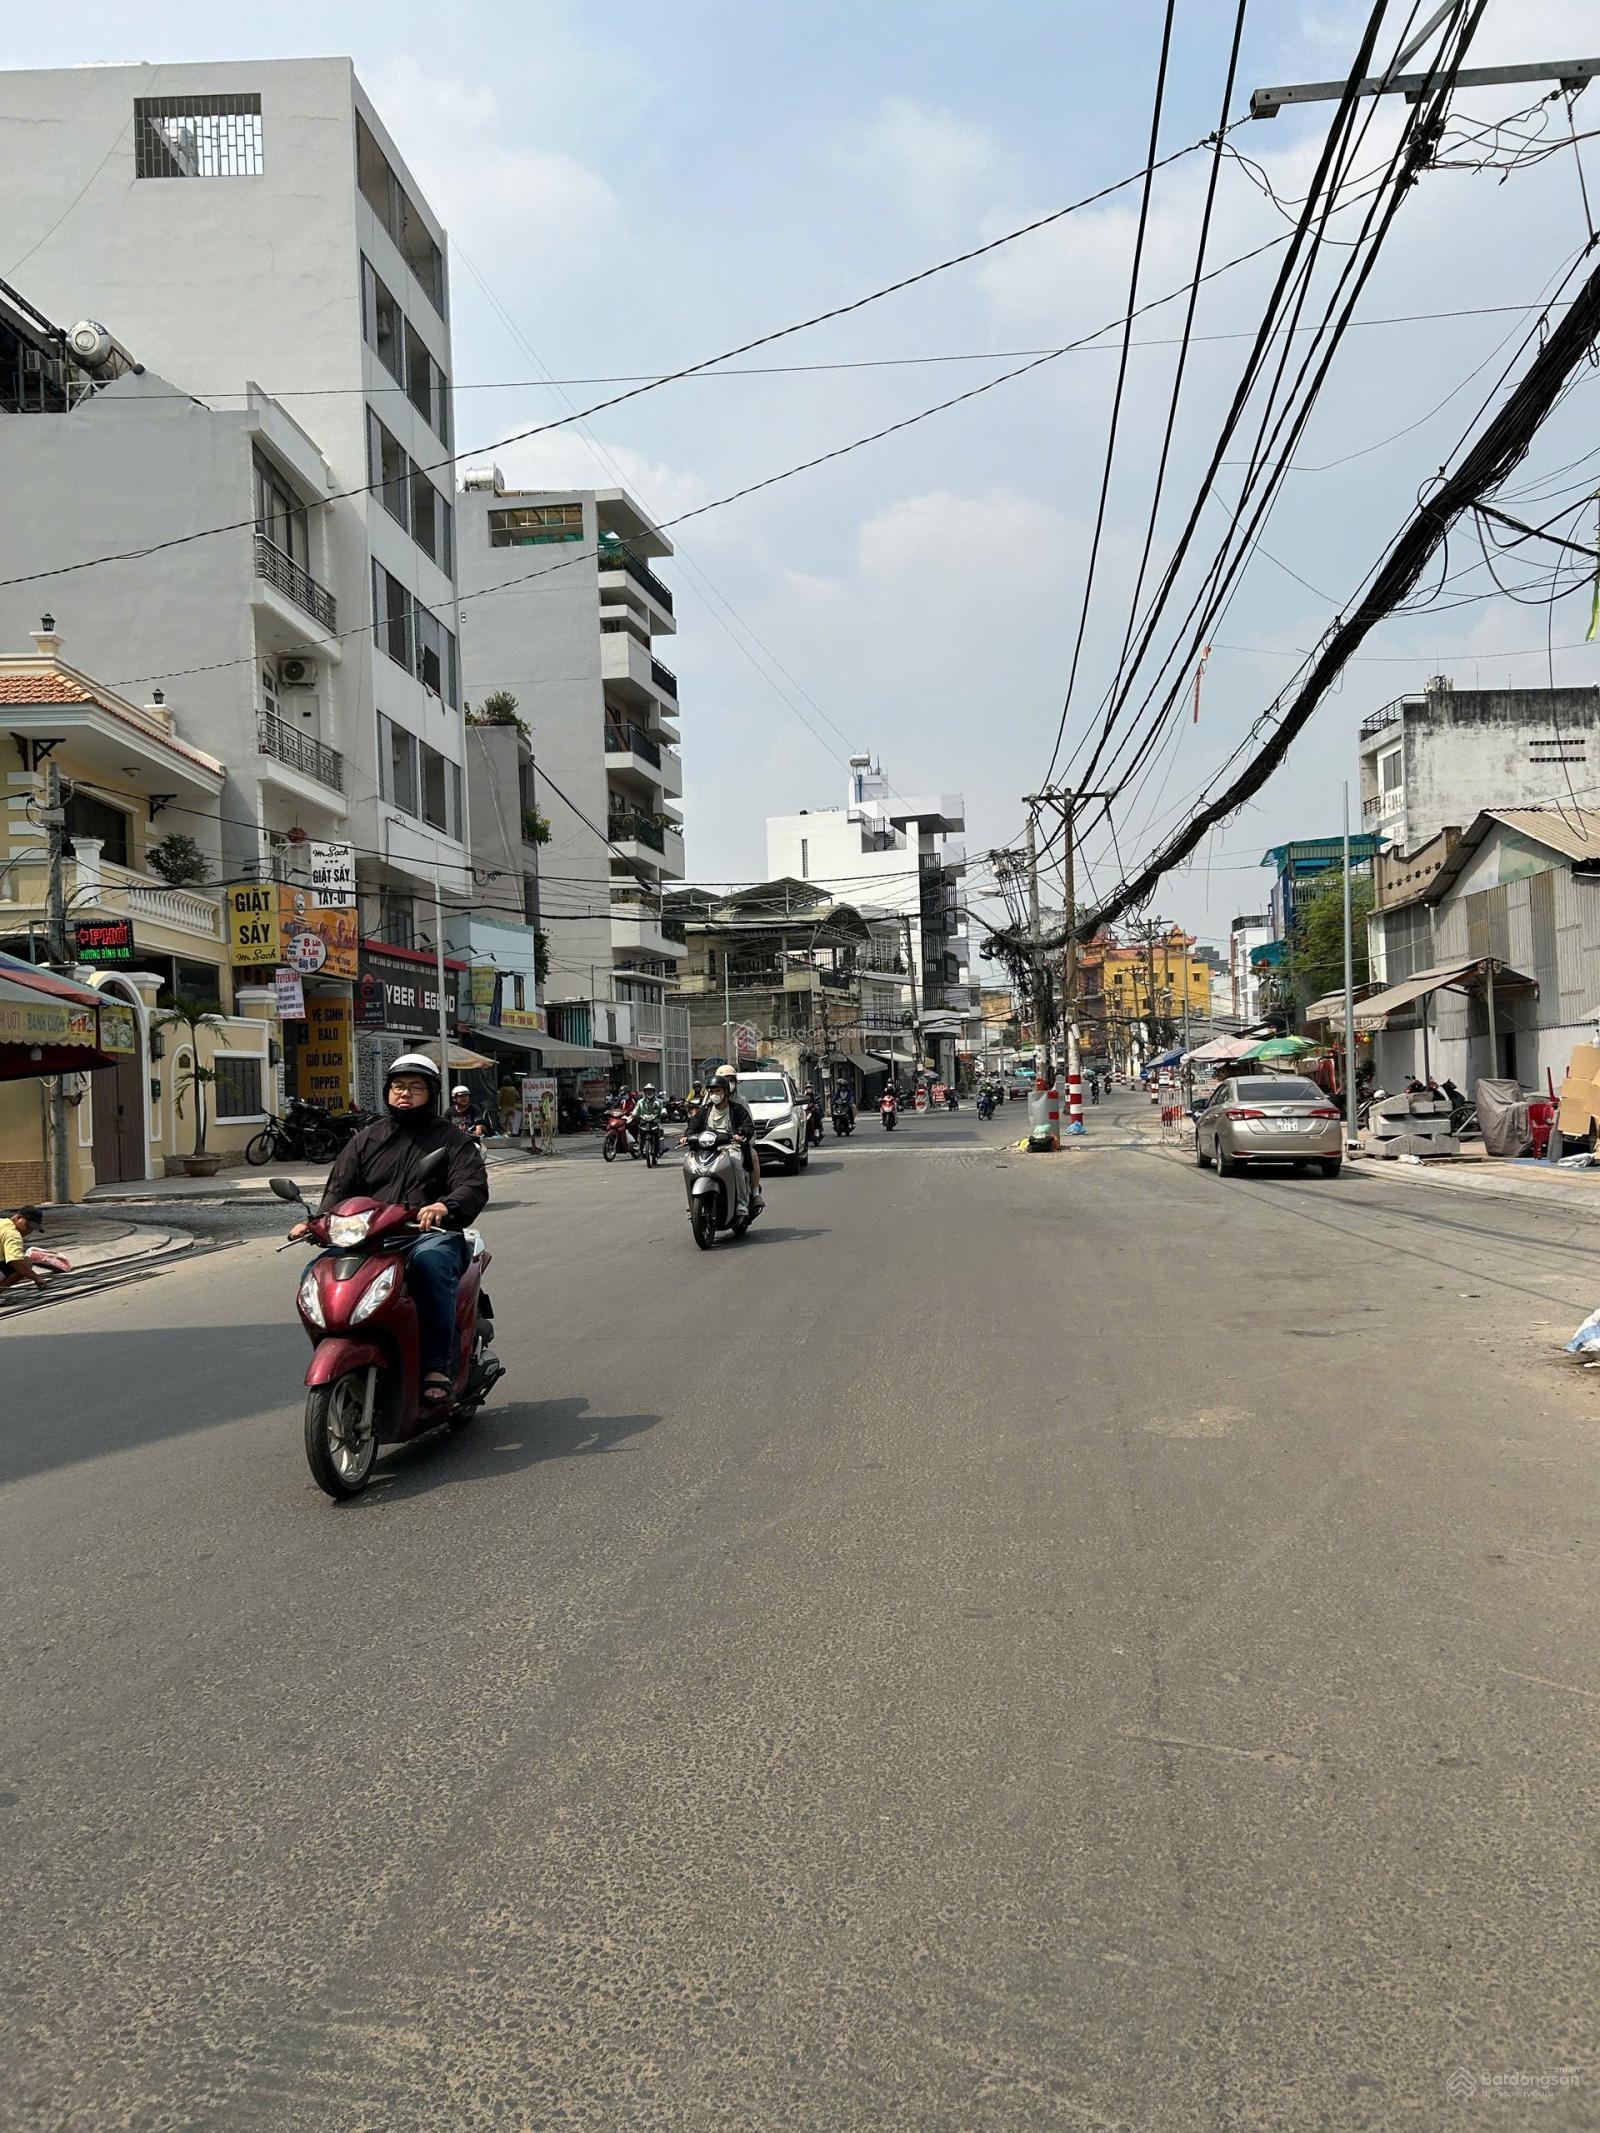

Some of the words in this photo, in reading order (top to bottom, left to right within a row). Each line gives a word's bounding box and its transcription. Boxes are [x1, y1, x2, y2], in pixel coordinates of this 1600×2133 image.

[312, 867, 331, 886] GIẶT
[334, 864, 350, 882] SẤY
[234, 887, 270, 916] GIẶT
[90, 922, 128, 946] PHỞ
[239, 916, 270, 945] SẤY
[385, 984, 415, 1007] YBER
[324, 1008, 343, 1020] SINH
[318, 1027, 339, 1041] BALO
[310, 1076, 340, 1090] TOPPER
